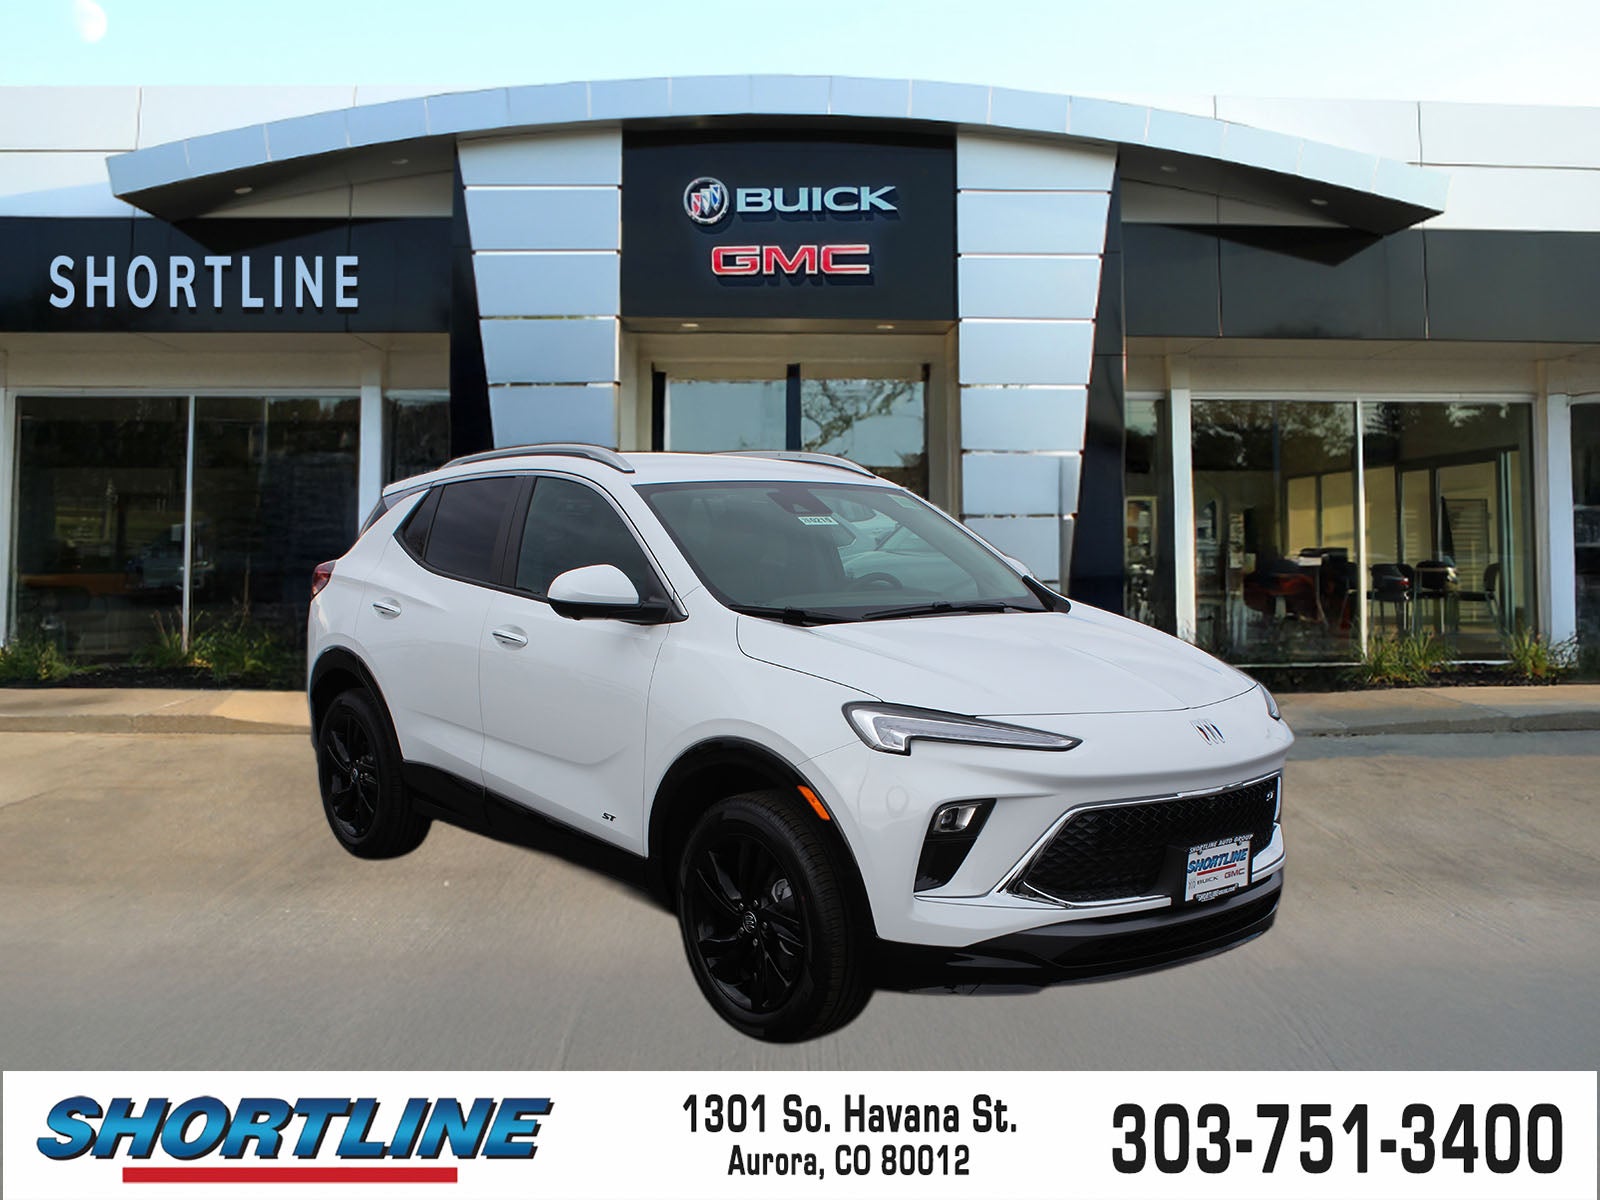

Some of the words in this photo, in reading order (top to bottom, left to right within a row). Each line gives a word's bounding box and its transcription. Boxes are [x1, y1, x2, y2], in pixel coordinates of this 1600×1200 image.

[736, 186, 898, 213] BUICK
[711, 244, 870, 275] GMC
[49, 255, 359, 309] SHORTLINE
[601, 812, 617, 822] ST
[1187, 848, 1248, 874] SHORTLINE
[1197, 876, 1218, 885] BUICK
[1224, 868, 1245, 879] GMC
